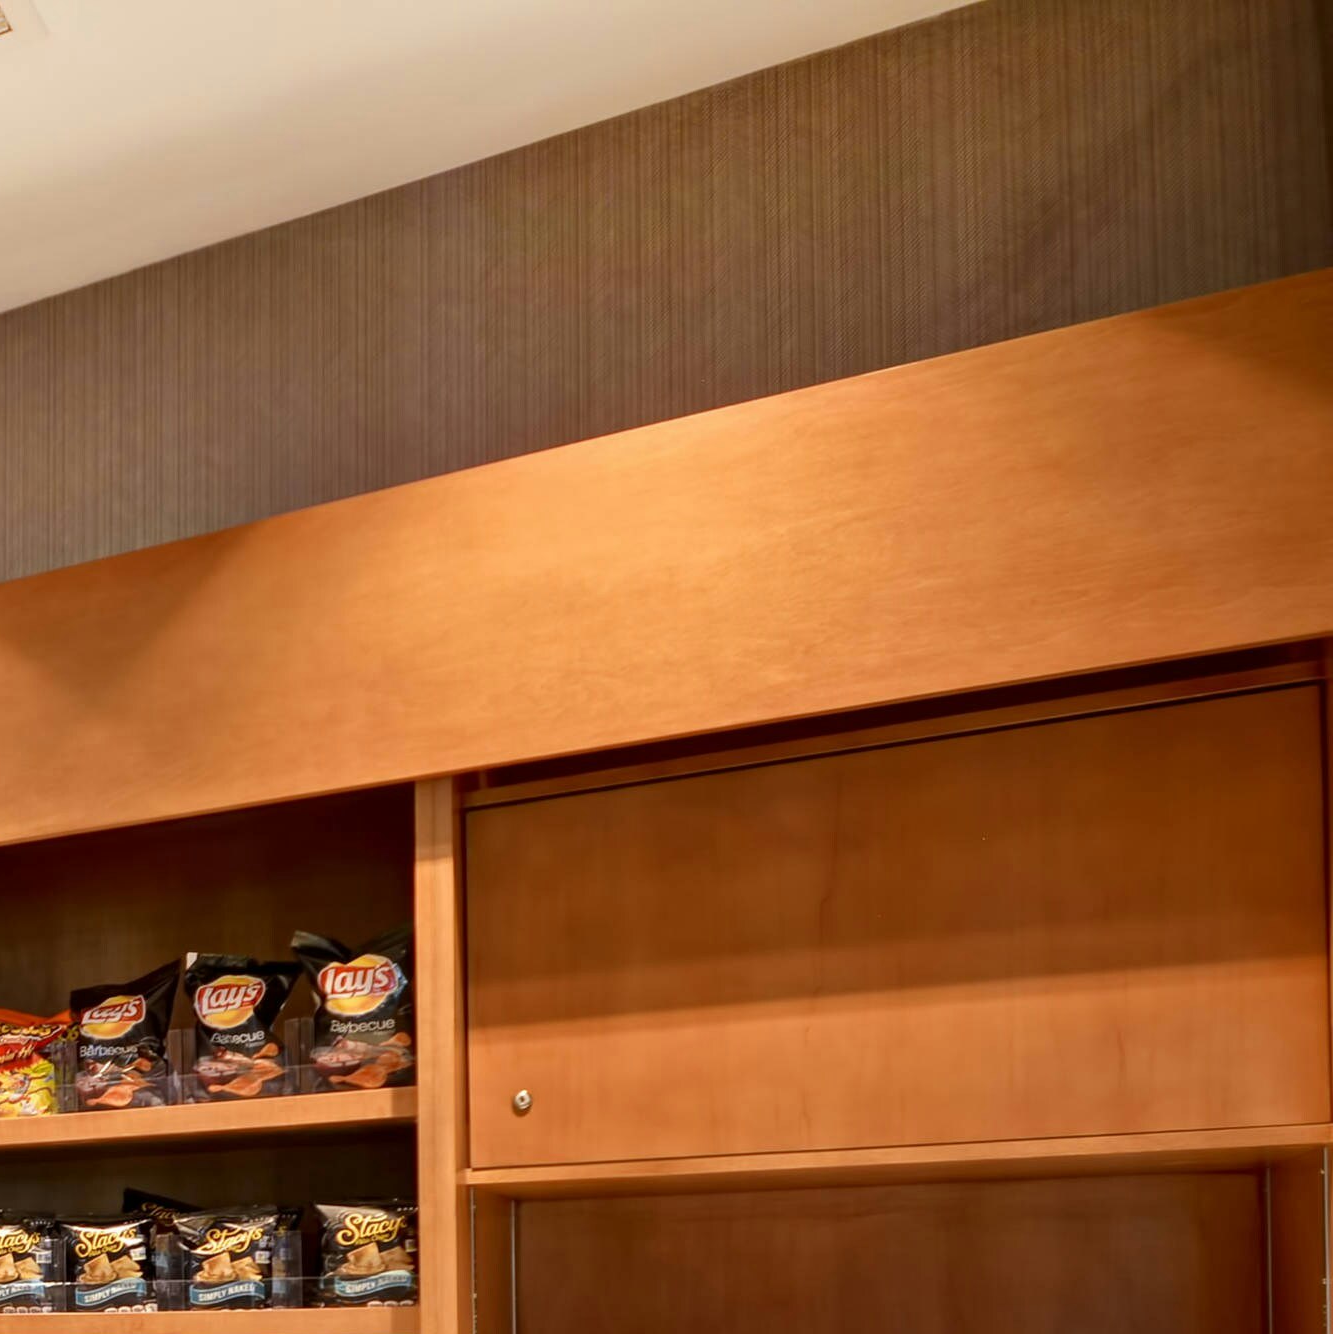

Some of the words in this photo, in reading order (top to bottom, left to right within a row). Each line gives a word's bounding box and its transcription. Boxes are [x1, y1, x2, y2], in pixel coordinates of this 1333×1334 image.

[325, 963, 390, 999] Lay's
[202, 981, 264, 1015] Lay's
[199, 1227, 263, 1254] Stacy's
[198, 1288, 227, 1302] SIMPLY
